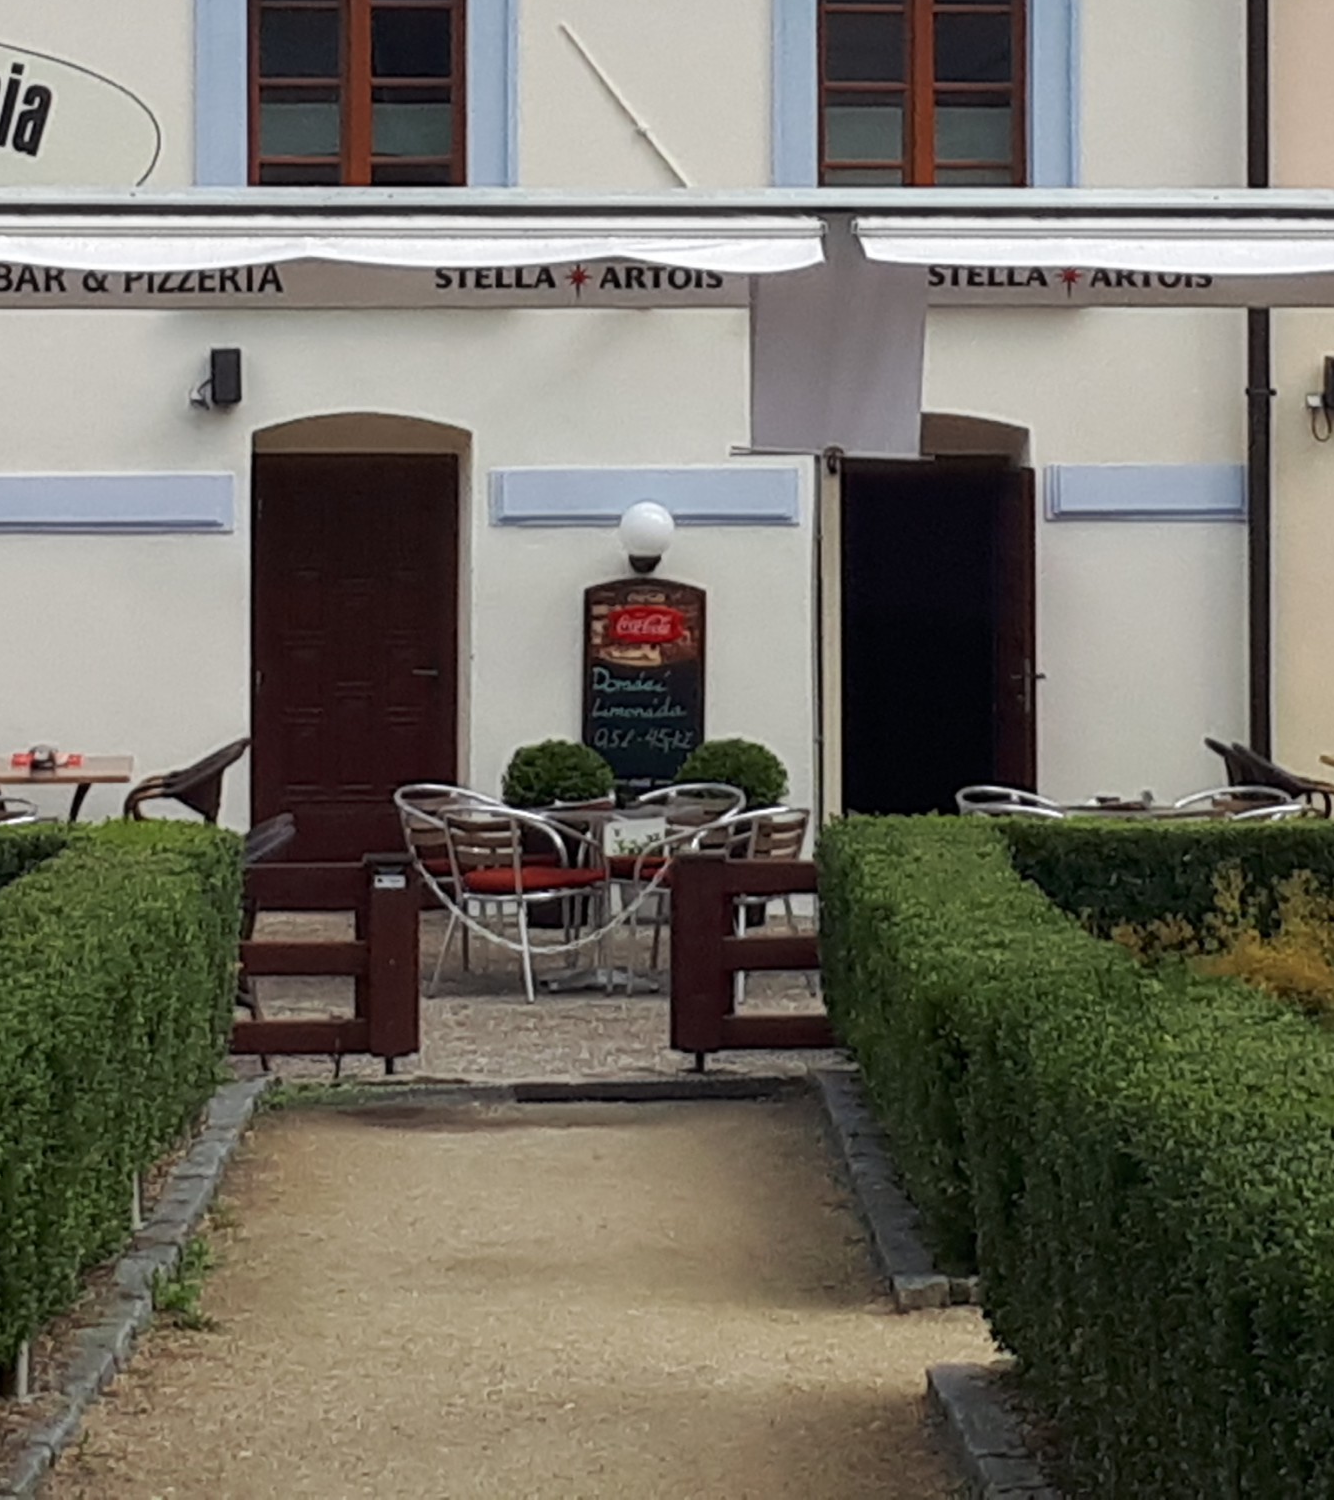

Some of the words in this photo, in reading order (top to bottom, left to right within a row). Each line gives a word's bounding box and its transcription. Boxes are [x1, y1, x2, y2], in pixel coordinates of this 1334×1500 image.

[81, 269, 109, 293] &
[123, 264, 284, 293] PIZZERIA
[435, 266, 557, 290] STELLA
[599, 265, 724, 290] ARTOIS
[927, 265, 1049, 288] STELLA
[1089, 268, 1214, 289] ARTOIS
